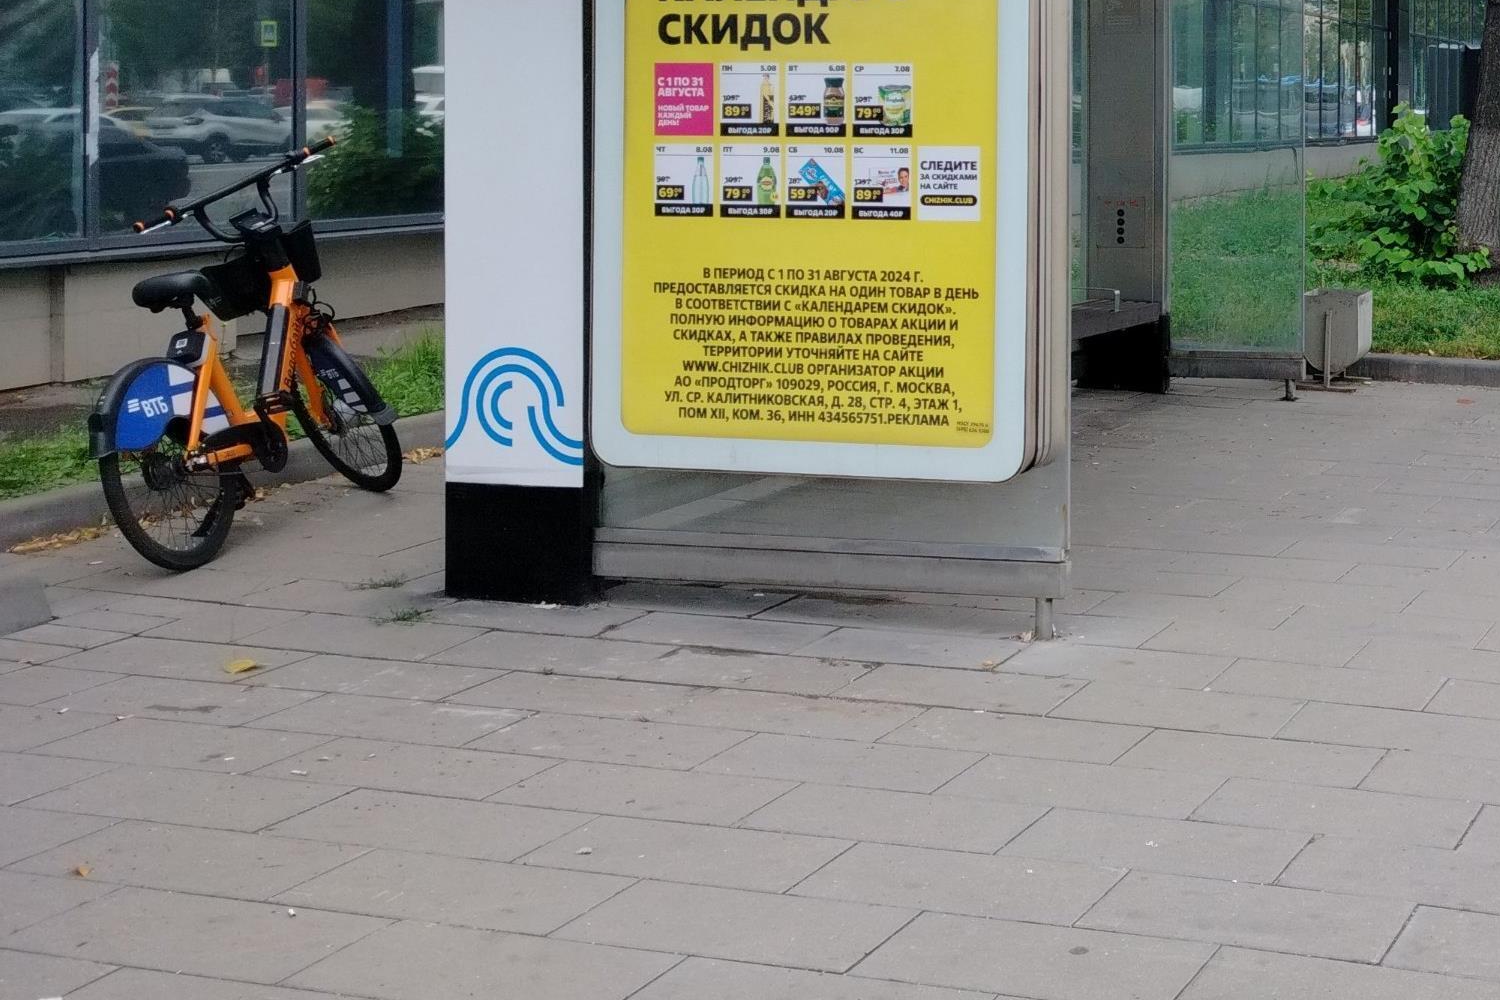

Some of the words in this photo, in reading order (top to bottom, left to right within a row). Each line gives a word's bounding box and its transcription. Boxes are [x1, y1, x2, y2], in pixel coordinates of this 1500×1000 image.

[657, 12, 831, 51] СКИДОК
[657, 77, 665, 87] С
[667, 77, 672, 87] 1
[674, 77, 690, 87] ПО
[692, 77, 704, 87] 31
[658, 87, 705, 97] АВГУСТА
[920, 160, 978, 172] СЛЕДИТЕ
[931, 173, 978, 181] СКИДКАМИ
[932, 182, 958, 190] САЙТЕ
[924, 196, 974, 204] CHIZHIK.CLUB
[703, 267, 710, 279] В
[714, 267, 764, 282] ПЕРИОД
[768, 268, 775, 280] С
[778, 269, 783, 280] 1
[787, 269, 804, 280] ПО
[808, 269, 820, 280] 31
[824, 269, 877, 282] АВГУСТА
[880, 270, 911, 283] 2024
[914, 271, 923, 283] Г.
[654, 281, 771, 298] ПРЕДОСТАВЛЯЕТСЯ
[774, 284, 826, 299] СКИДКА
[830, 285, 846, 297] НА
[850, 285, 886, 300] ОДИН
[889, 286, 930, 299] ТОВАР
[934, 287, 942, 299] В
[944, 287, 979, 302] ДЕНЬ
[676, 298, 683, 309] В
[686, 298, 780, 312] СООТВЕТСТВИИ
[784, 300, 791, 311] С
[795, 300, 888, 316] «КАЛЕНДАРЕМ
[892, 302, 956, 317] СКИДОК».
[670, 313, 725, 326] ПОЛНУЮ
[728, 314, 824, 330] ИНФОРМАЦИЮ
[828, 317, 837, 328] О
[840, 317, 898, 330] ТОВАРАХ
[900, 318, 946, 333] АКЦИИ
[950, 319, 958, 331] И
[673, 329, 736, 344] СКИДКАХ,
[739, 330, 747, 342] А
[750, 330, 792, 343] ТАКЖЕ
[796, 331, 862, 345] ПРАВИЛАХ
[866, 333, 954, 348] ПРОВЕДЕНИЯ,
[702, 345, 782, 358] ТЕРРИТОРИИ
[786, 346, 860, 360] УТОЧНЯЙТЕ
[863, 349, 880, 361] НА
[883, 349, 923, 362] САЙТЕ
[682, 360, 804, 375] WWW.CHIZHIK.CLUB
[807, 363, 896, 377] ОРГАНИЗАТОР
[899, 366, 944, 379] АКЦИИ
[674, 375, 691, 387] АО
[695, 376, 772, 391] «ПРОДТОРГ»
[776, 378, 824, 393] 109029,
[827, 380, 880, 395] РОССИЯ,
[884, 381, 893, 393] Г.
[897, 381, 955, 397] МОСКВА,
[141, 396, 169, 418] ВТБ
[664, 391, 683, 402] УЛ.
[686, 391, 704, 403] СР.
[707, 392, 828, 409] КАЛИТНИКОВСКАЯ,
[831, 396, 844, 409] Д.
[848, 396, 866, 411] 28,
[870, 396, 895, 409] СТР.
[898, 397, 910, 412] 4,
[914, 398, 949, 410] ЭТАЖ
[953, 399, 962, 413] 1,
[679, 407, 707, 418] ПОМ
[710, 408, 729, 421] XII,
[732, 408, 764, 421] КОМ.
[767, 409, 785, 423] 36,
[788, 410, 815, 422] ИНН
[818, 411, 949, 426] 434565751.РЕКЛАМА
